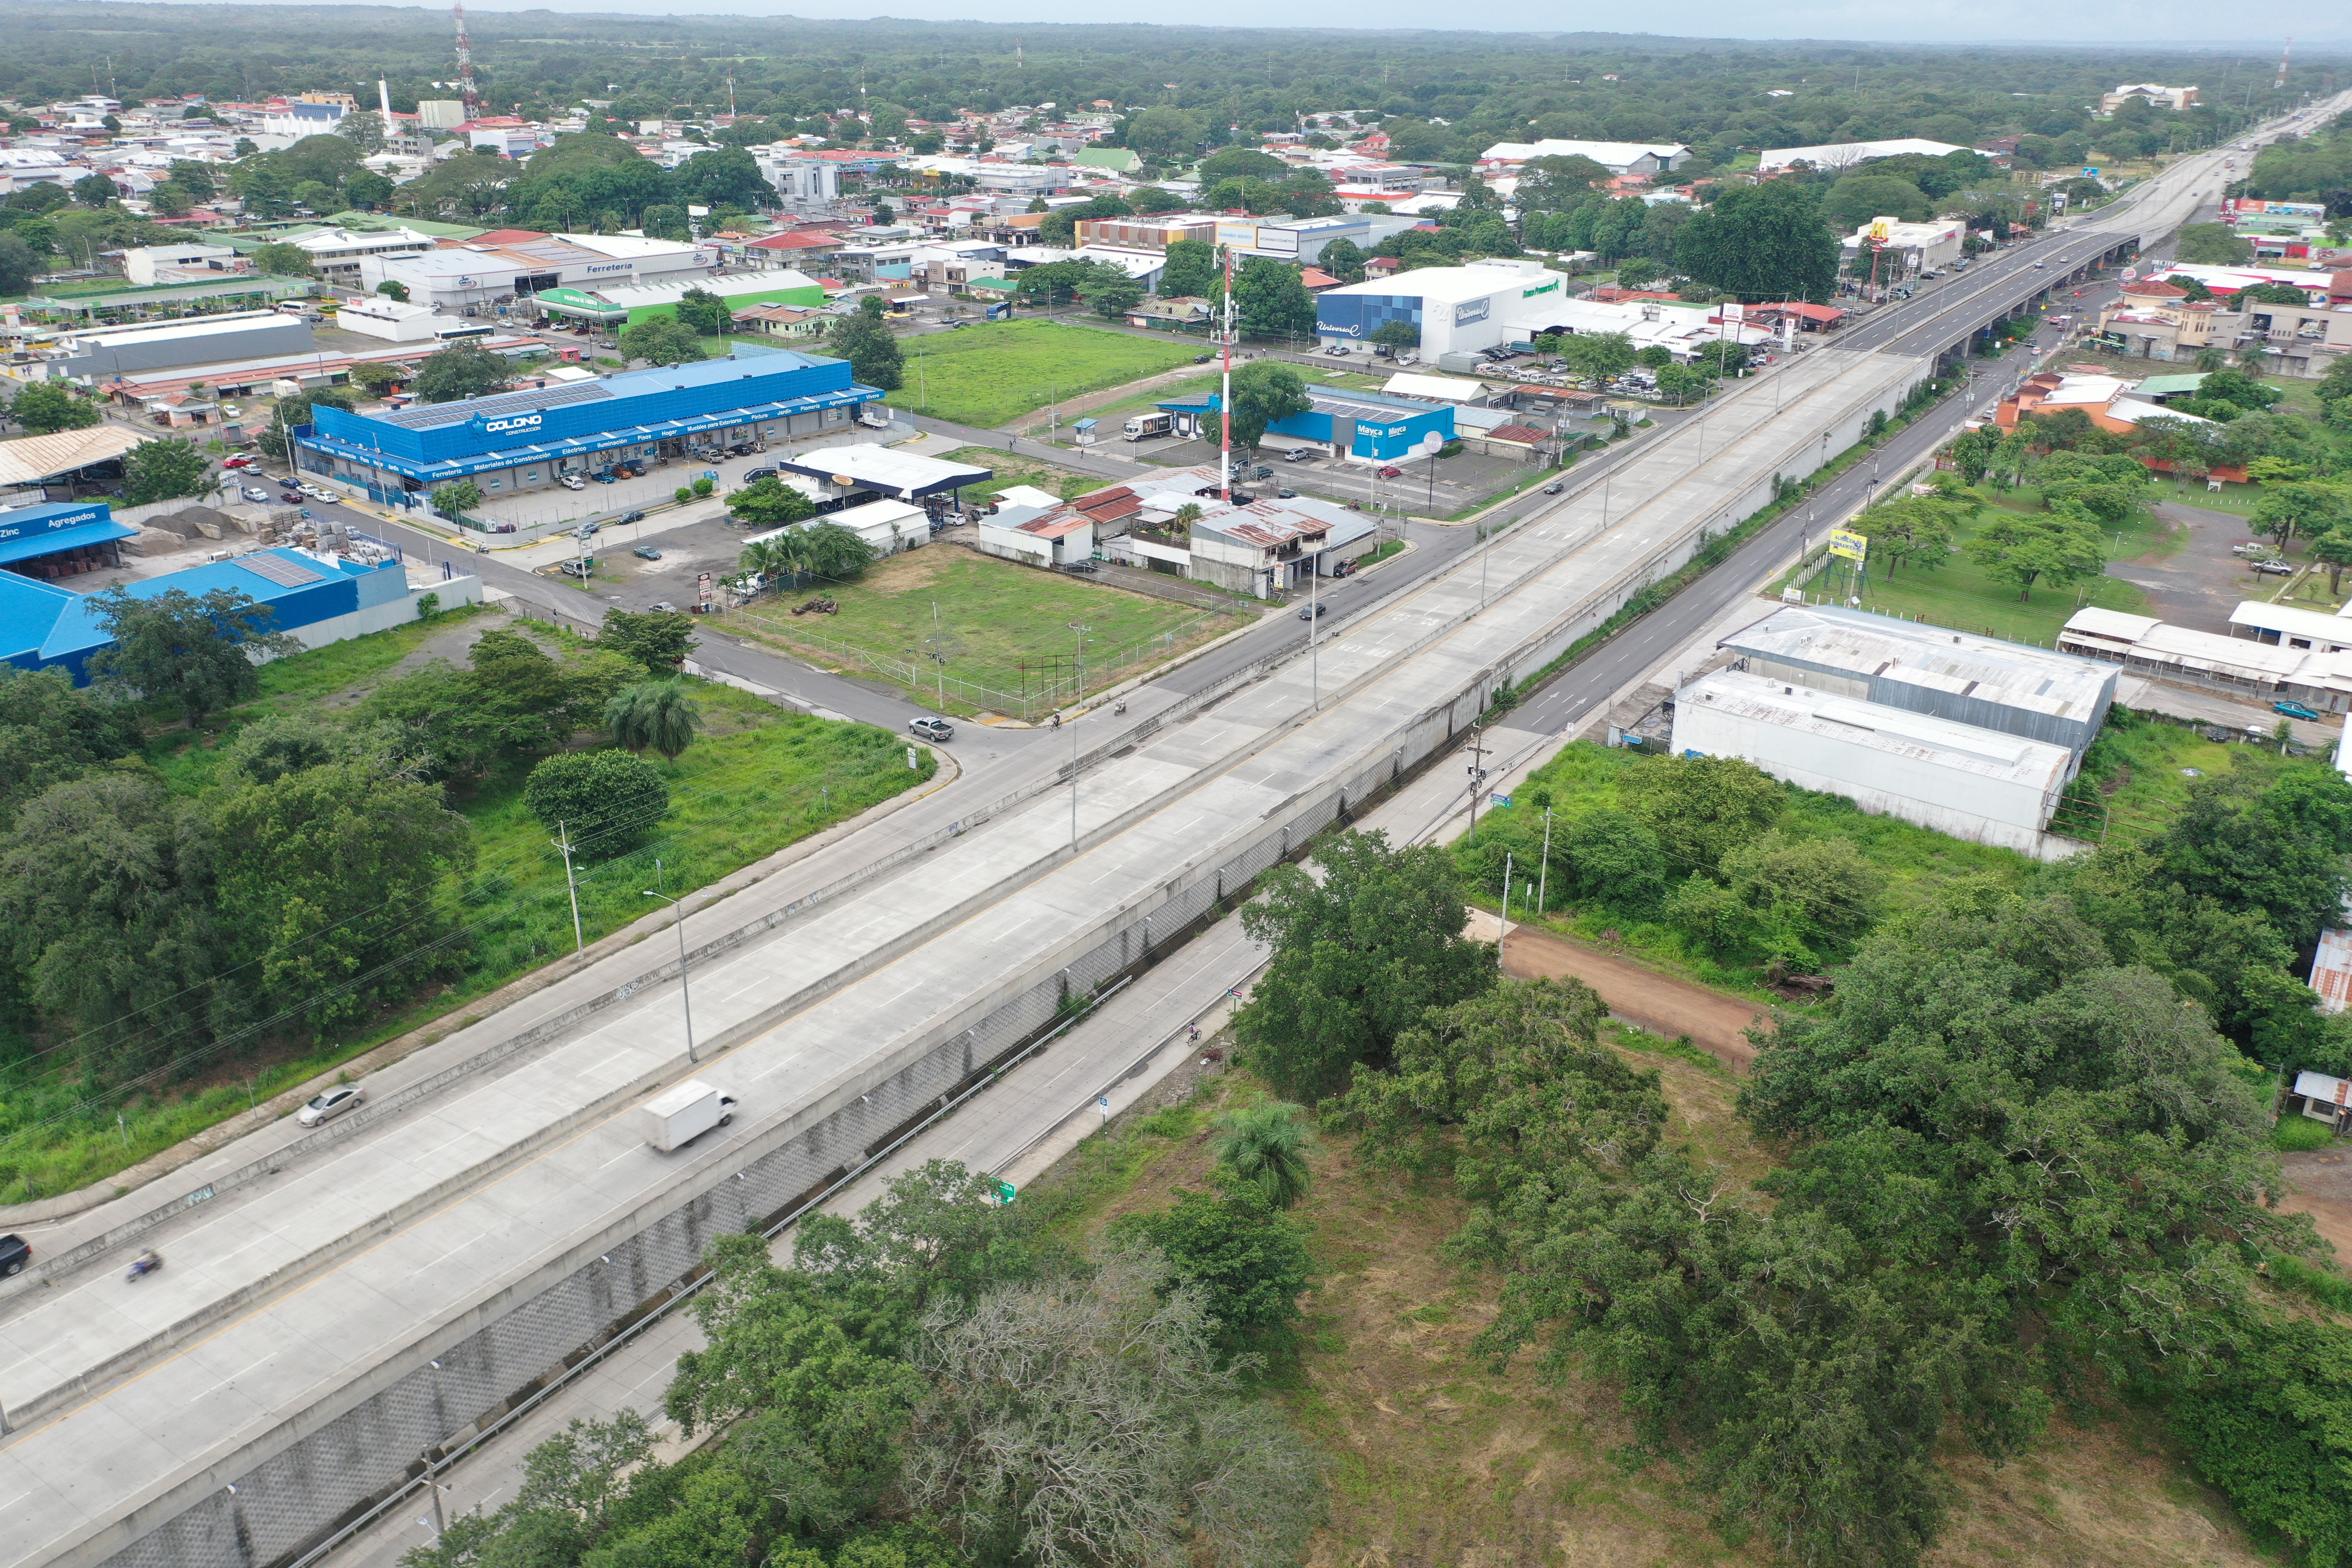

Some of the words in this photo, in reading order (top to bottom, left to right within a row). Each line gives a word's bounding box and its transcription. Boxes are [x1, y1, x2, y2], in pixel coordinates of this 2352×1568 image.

[587, 263, 632, 273] Ferretería
[1457, 300, 1489, 320] Universal
[1317, 321, 1360, 337] Universal
[829, 396, 858, 406] Agropecuario
[487, 415, 542, 432] COLONO
[719, 418, 742, 426] Exteriores
[506, 426, 541, 436] CONSTRUCCIÓN
[1358, 425, 1383, 436] Mayca
[1388, 426, 1407, 436] Mayca
[597, 438, 628, 448] Iluminación
[1424, 438, 1442, 447] Mayca
[562, 446, 587, 455] Eléctrico
[474, 461, 504, 471] Materiales
[514, 452, 551, 464] Construcción
[403, 468, 415, 476] Vivero
[432, 468, 462, 478] Ferretería
[49, 512, 96, 528] Agregados
[0, 528, 20, 538] Zinc
[1834, 535, 1855, 543] ALMACEN
